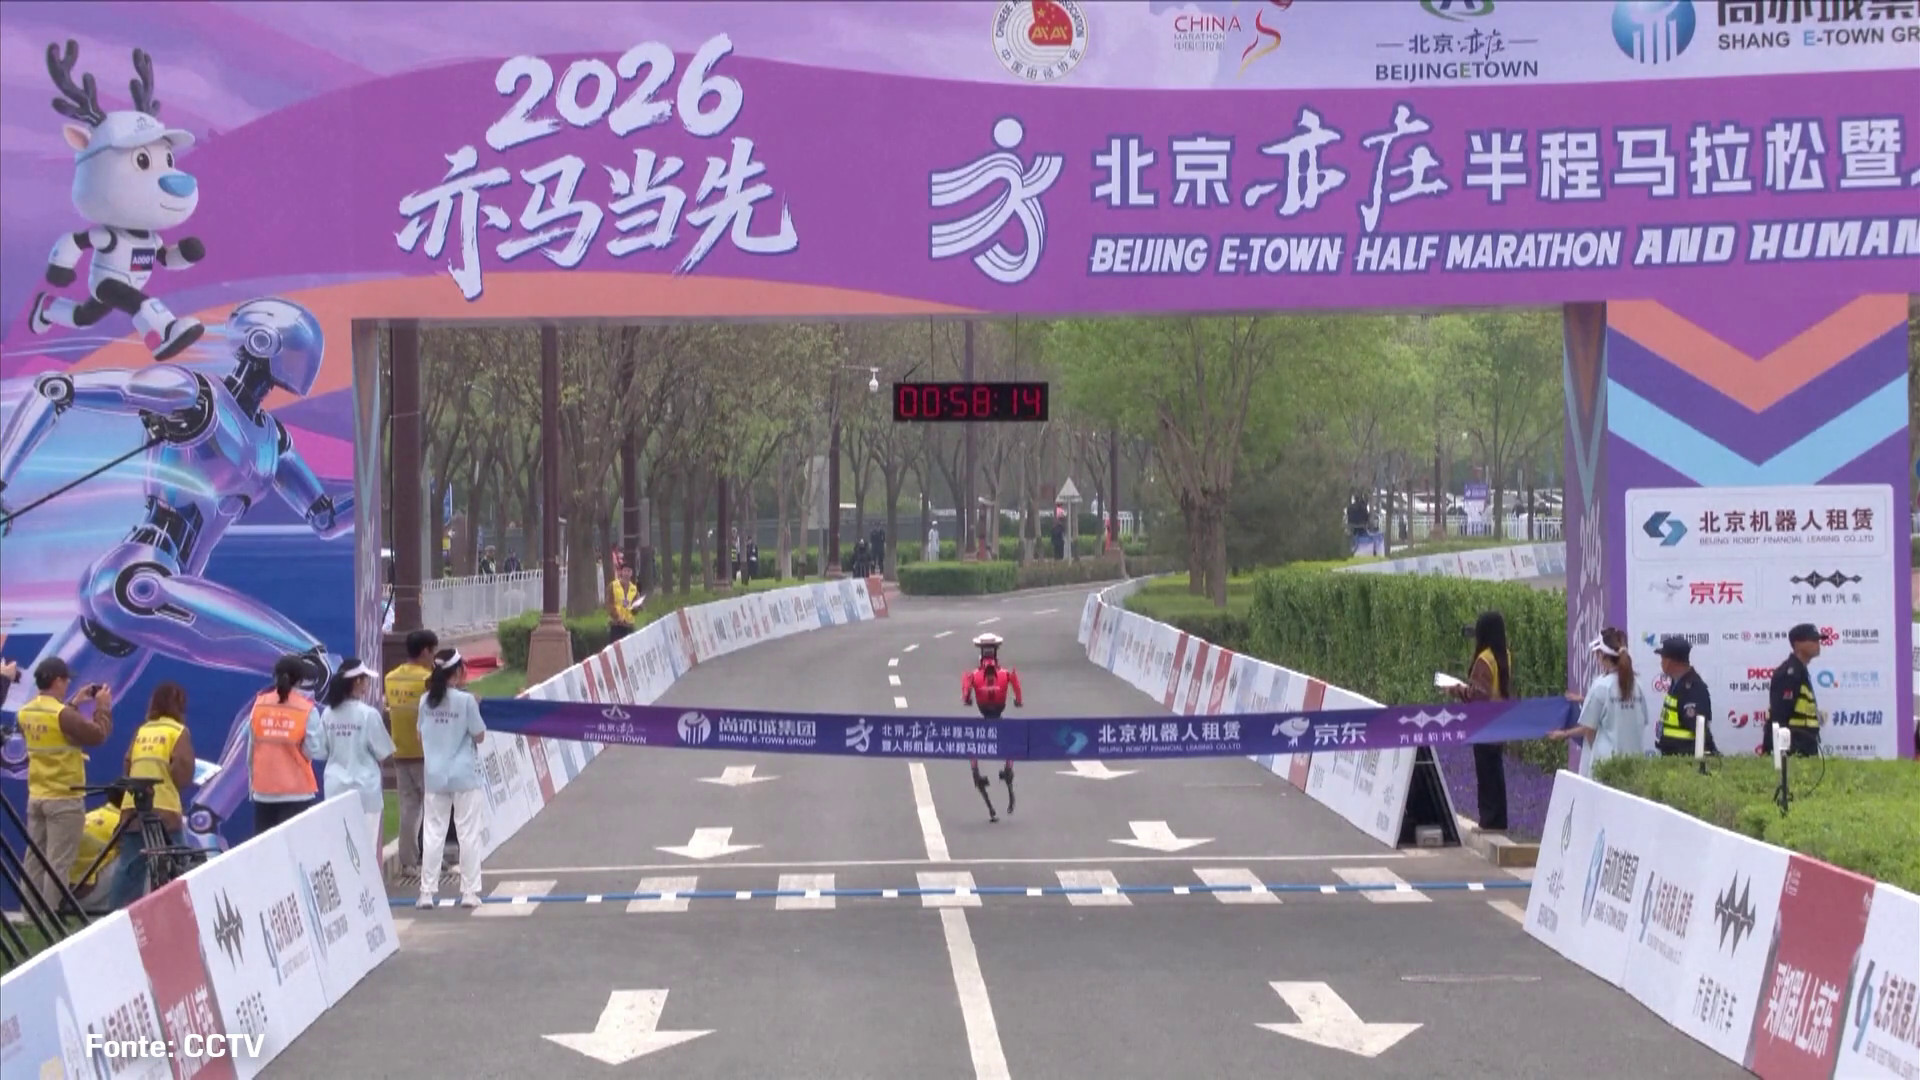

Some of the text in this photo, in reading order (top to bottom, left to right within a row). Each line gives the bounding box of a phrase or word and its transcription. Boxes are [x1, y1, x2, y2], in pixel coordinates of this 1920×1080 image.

[1174, 16, 1242, 32] CHINA
[1174, 33, 1226, 41] MARATHON
[1718, 32, 1791, 50] SHANG
[1803, 28, 1885, 46] E-TOWN
[1375, 61, 1539, 83] BEIJINGETOWN
[486, 32, 744, 151] 2026
[1095, 104, 1920, 233] 北京亦庄半程马拉松暨
[393, 136, 800, 302] 亦马当先
[1091, 237, 1208, 273] BEIJING
[1218, 237, 1344, 273] E-TOWN
[1355, 235, 1440, 272] HALF
[1445, 230, 1623, 272] MARATHON
[1633, 224, 1737, 266] AND
[899, 386, 1042, 417] 00:58:14
[1699, 507, 1875, 534] 北京机器人租赁
[1688, 581, 1744, 605] 京东
[718, 734, 748, 743] SHANG
[786, 736, 817, 747] GROUP
[1098, 720, 1241, 744] 北京机器人租赁
[1313, 721, 1368, 746] 京东
